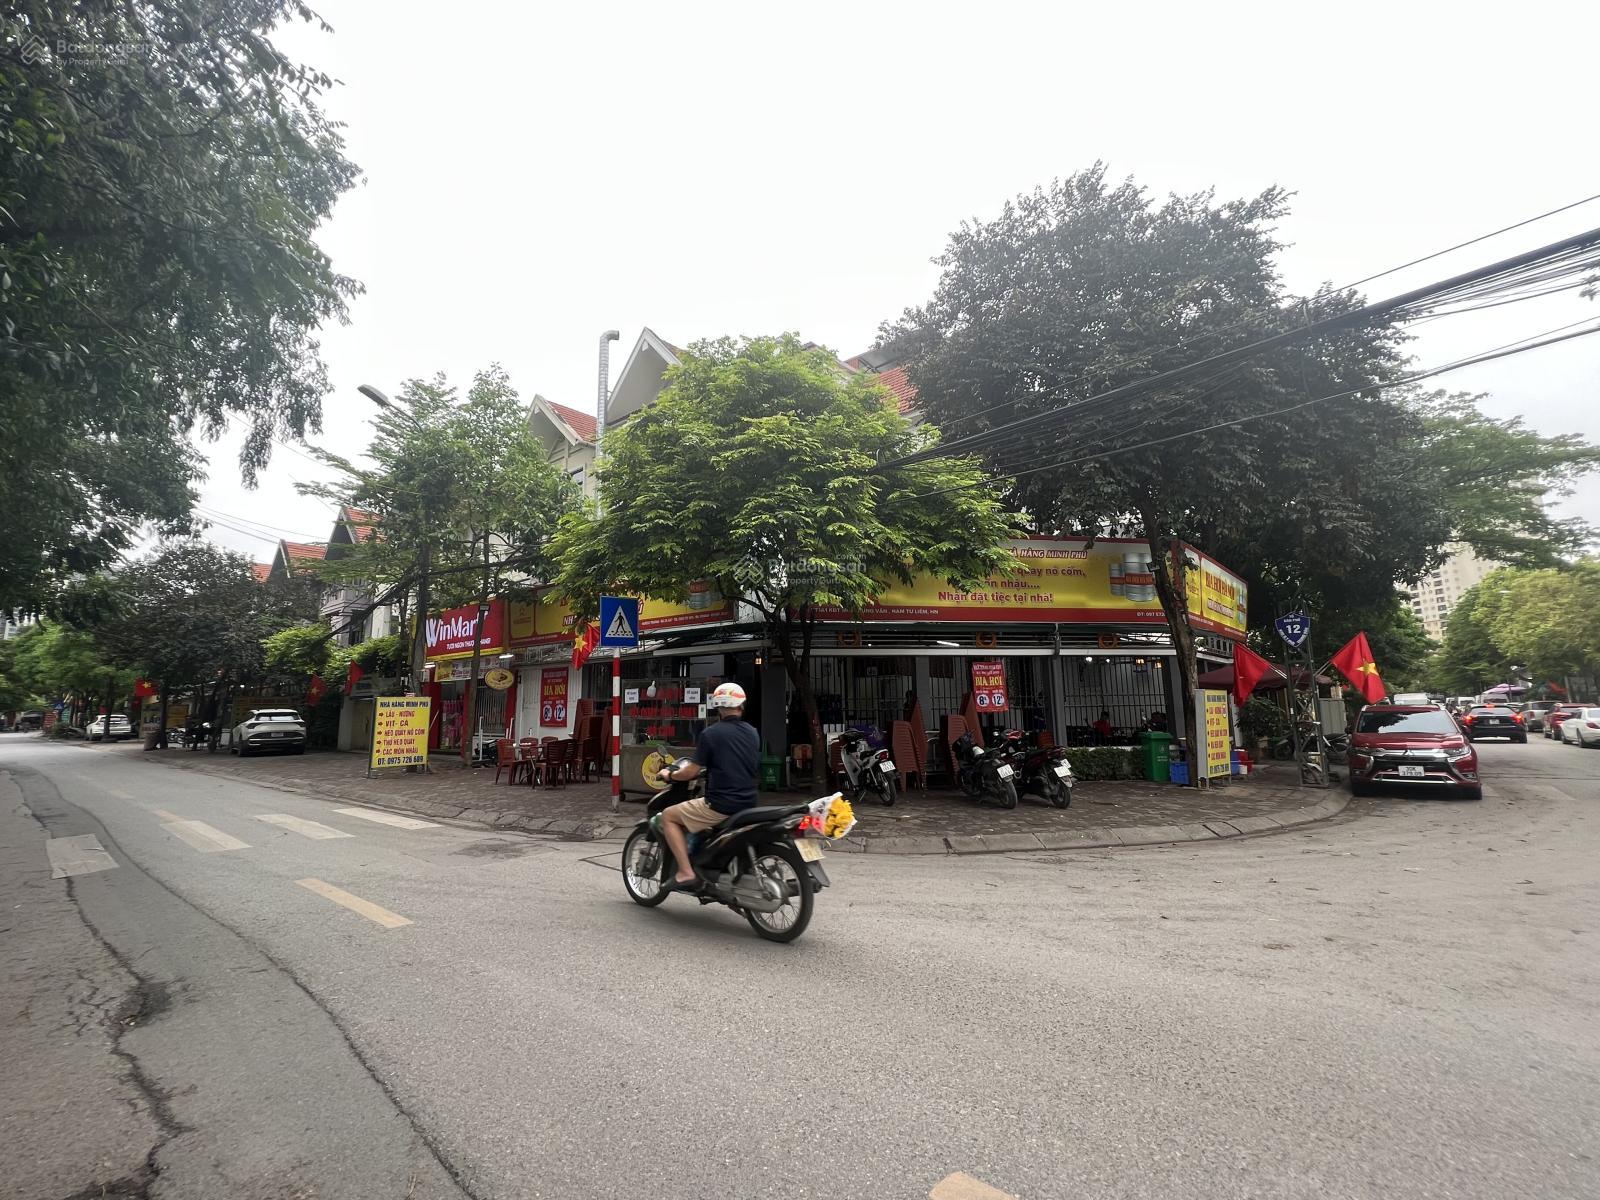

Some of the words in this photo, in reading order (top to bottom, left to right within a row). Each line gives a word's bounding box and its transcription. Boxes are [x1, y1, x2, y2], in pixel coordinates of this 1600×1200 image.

[937, 591, 967, 603] Nhận
[970, 591, 990, 604] đặt
[991, 591, 1012, 604] tiệc
[1013, 592, 1028, 604] tại
[1285, 624, 1301, 634] 12
